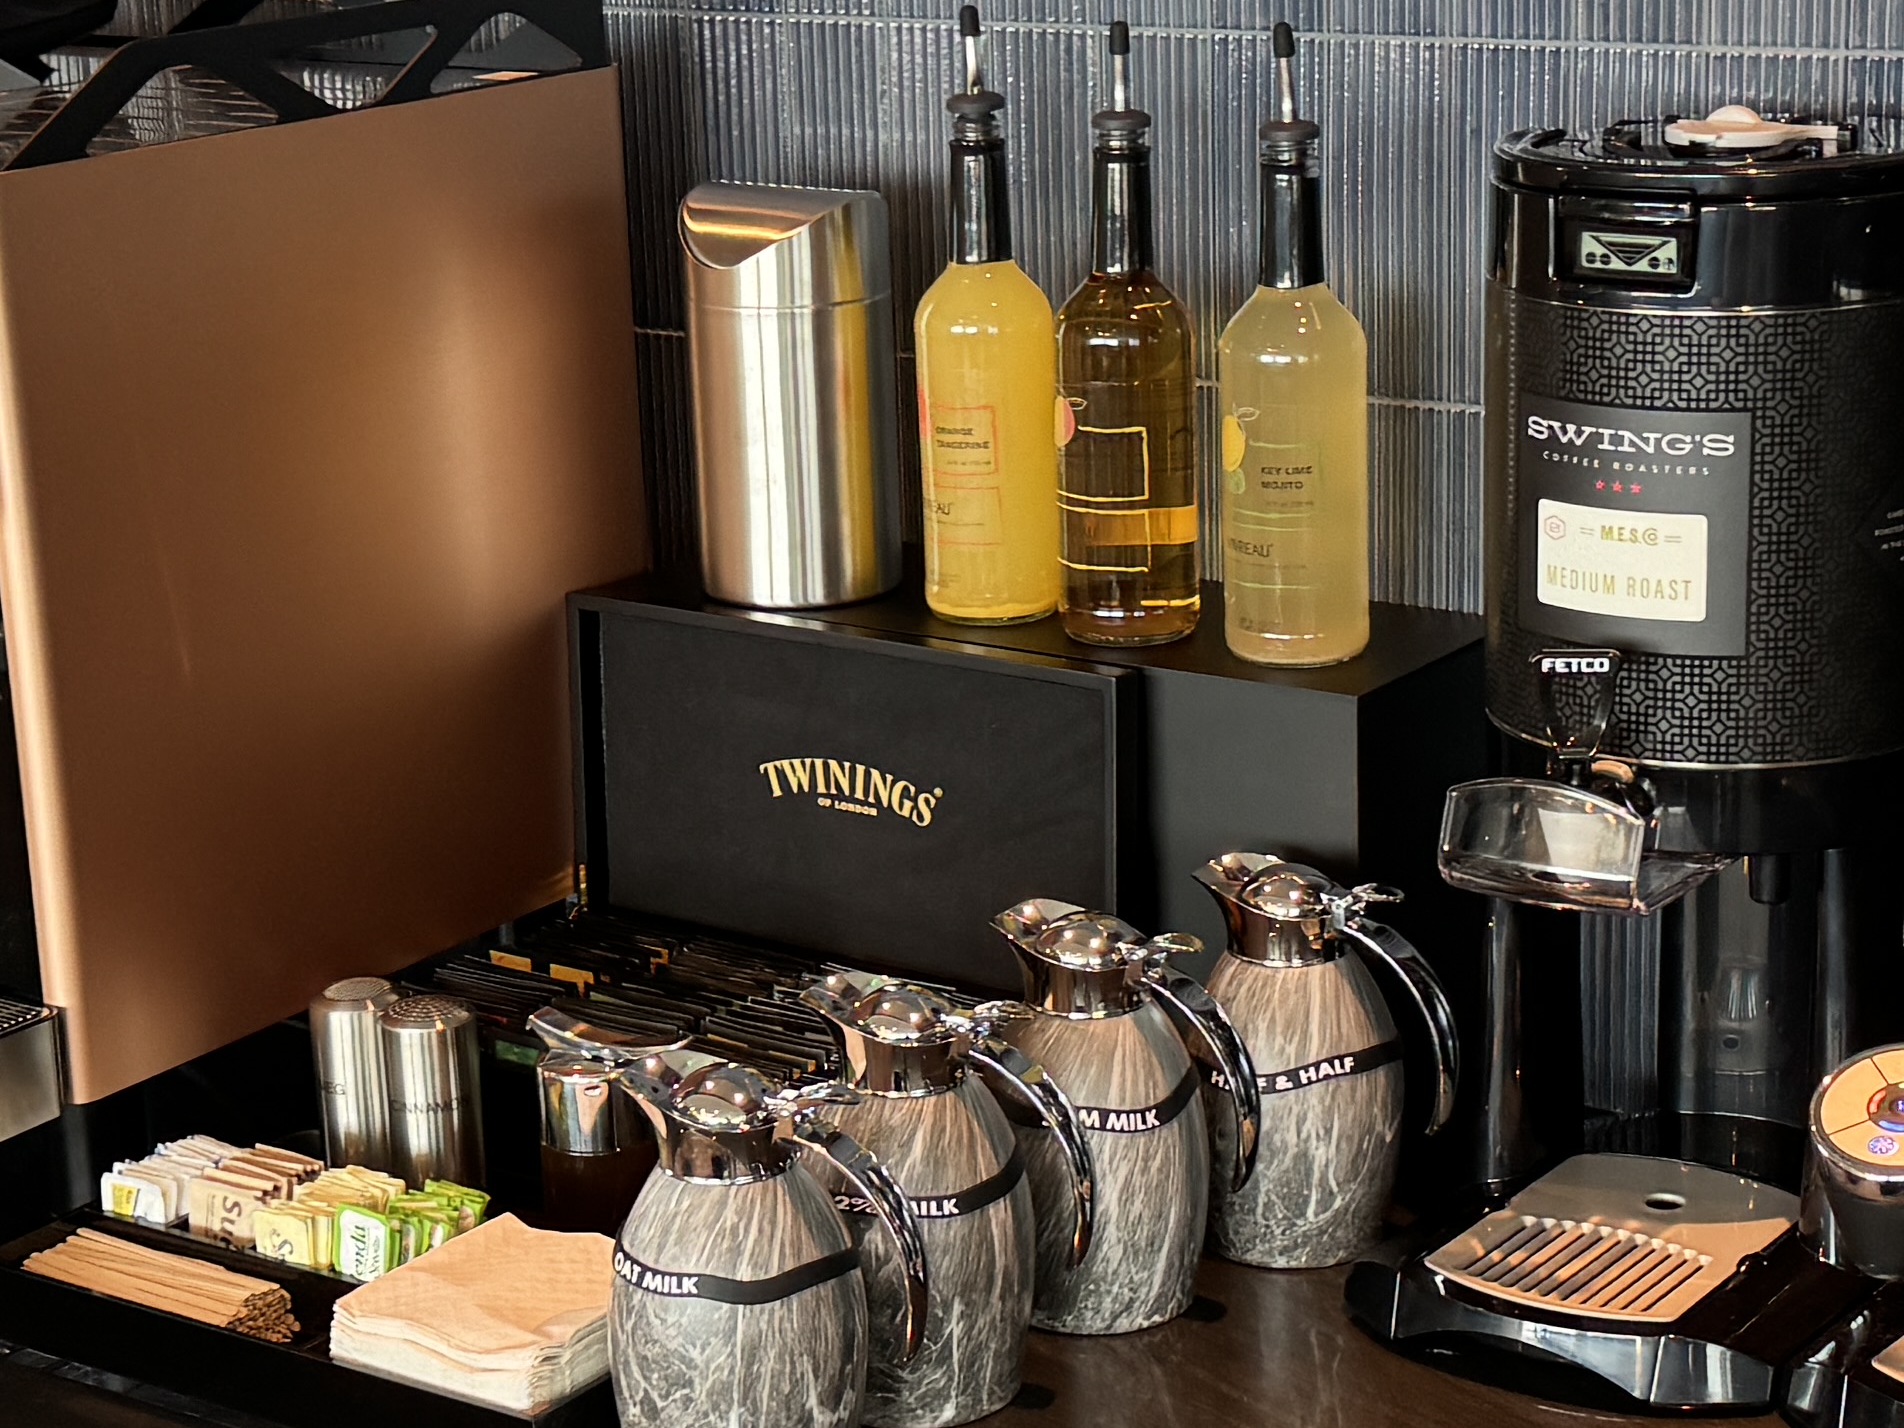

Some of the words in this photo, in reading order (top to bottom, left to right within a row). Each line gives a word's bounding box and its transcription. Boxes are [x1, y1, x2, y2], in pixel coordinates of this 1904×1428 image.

[1527, 415, 1735, 457] SWING'S
[1542, 450, 1601, 469] COFFEE
[1612, 460, 1710, 476] ROASTERS
[1546, 563, 1617, 596] MEDIUM
[1626, 575, 1693, 602] ROAST
[1541, 657, 1610, 673] FETCO
[816, 797, 833, 808] OF
[834, 800, 878, 817] LONDON
[1210, 1070, 1267, 1091] HF
[1275, 1075, 1294, 1091] &
[1298, 1056, 1355, 1084] HALF
[1105, 1108, 1161, 1131] MILK
[614, 1252, 642, 1283] OAT
[641, 1271, 699, 1294] MILK
